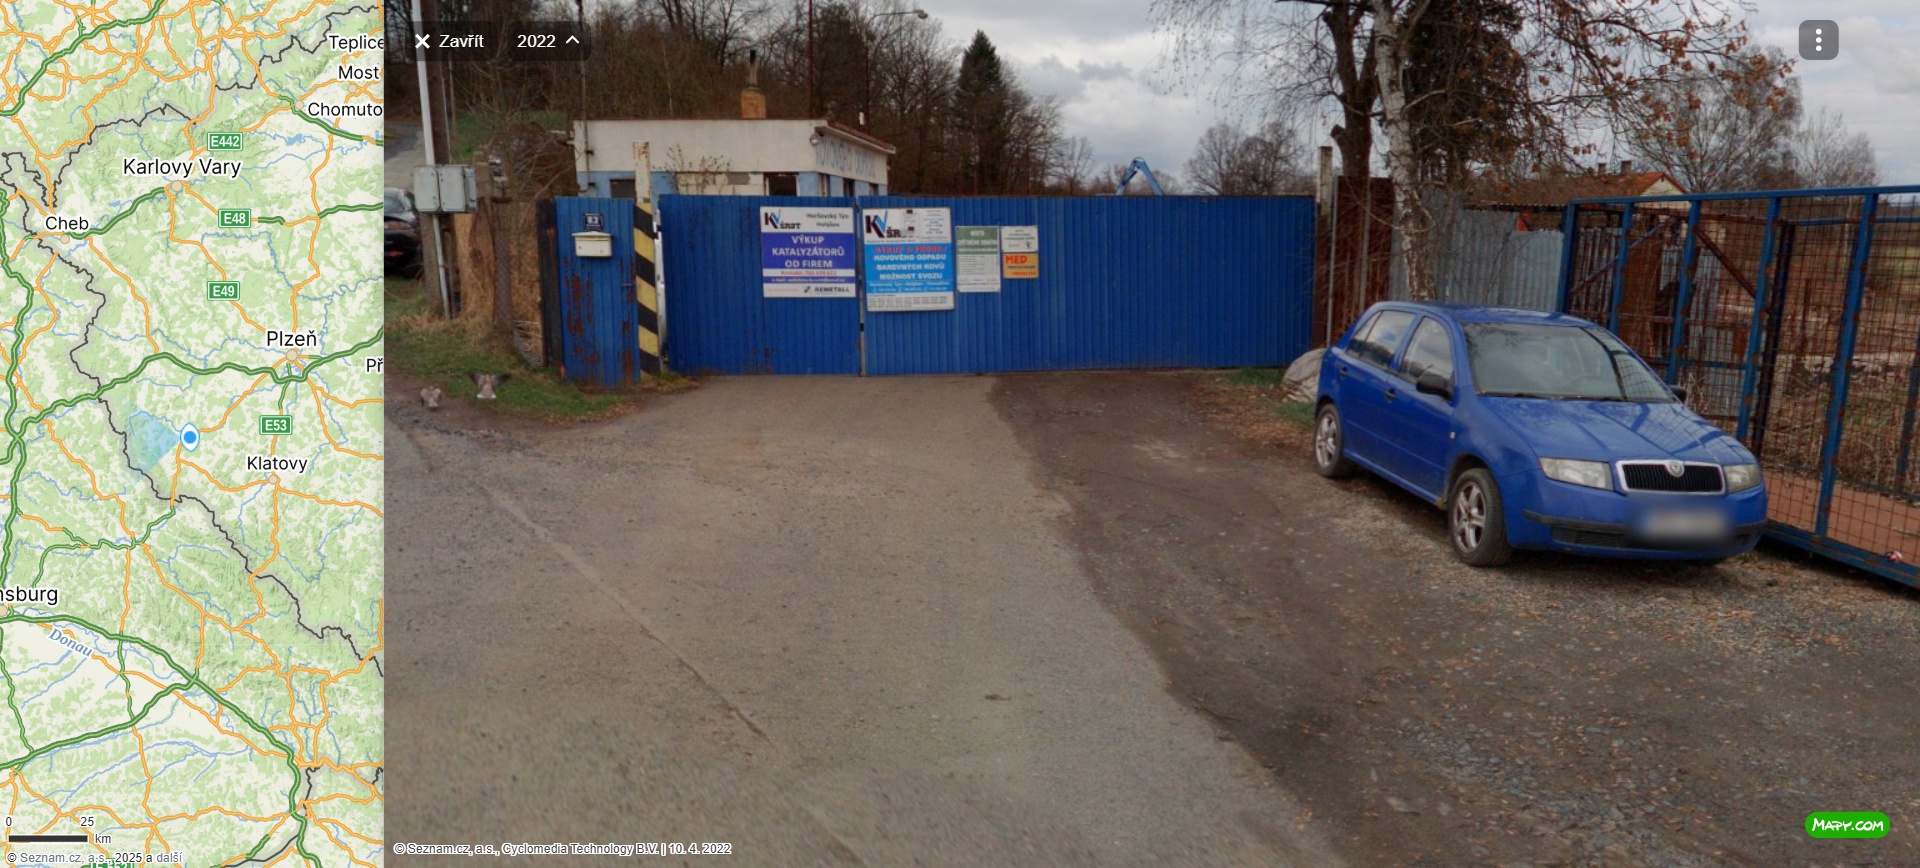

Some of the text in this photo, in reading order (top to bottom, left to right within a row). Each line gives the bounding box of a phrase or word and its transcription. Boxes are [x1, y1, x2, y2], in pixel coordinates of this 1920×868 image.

[791, 234, 825, 244] VÝKUP
[772, 246, 845, 256] KATALYZÁTORŮ
[785, 259, 833, 268] OD FIREM
[1005, 255, 1028, 264] MED
